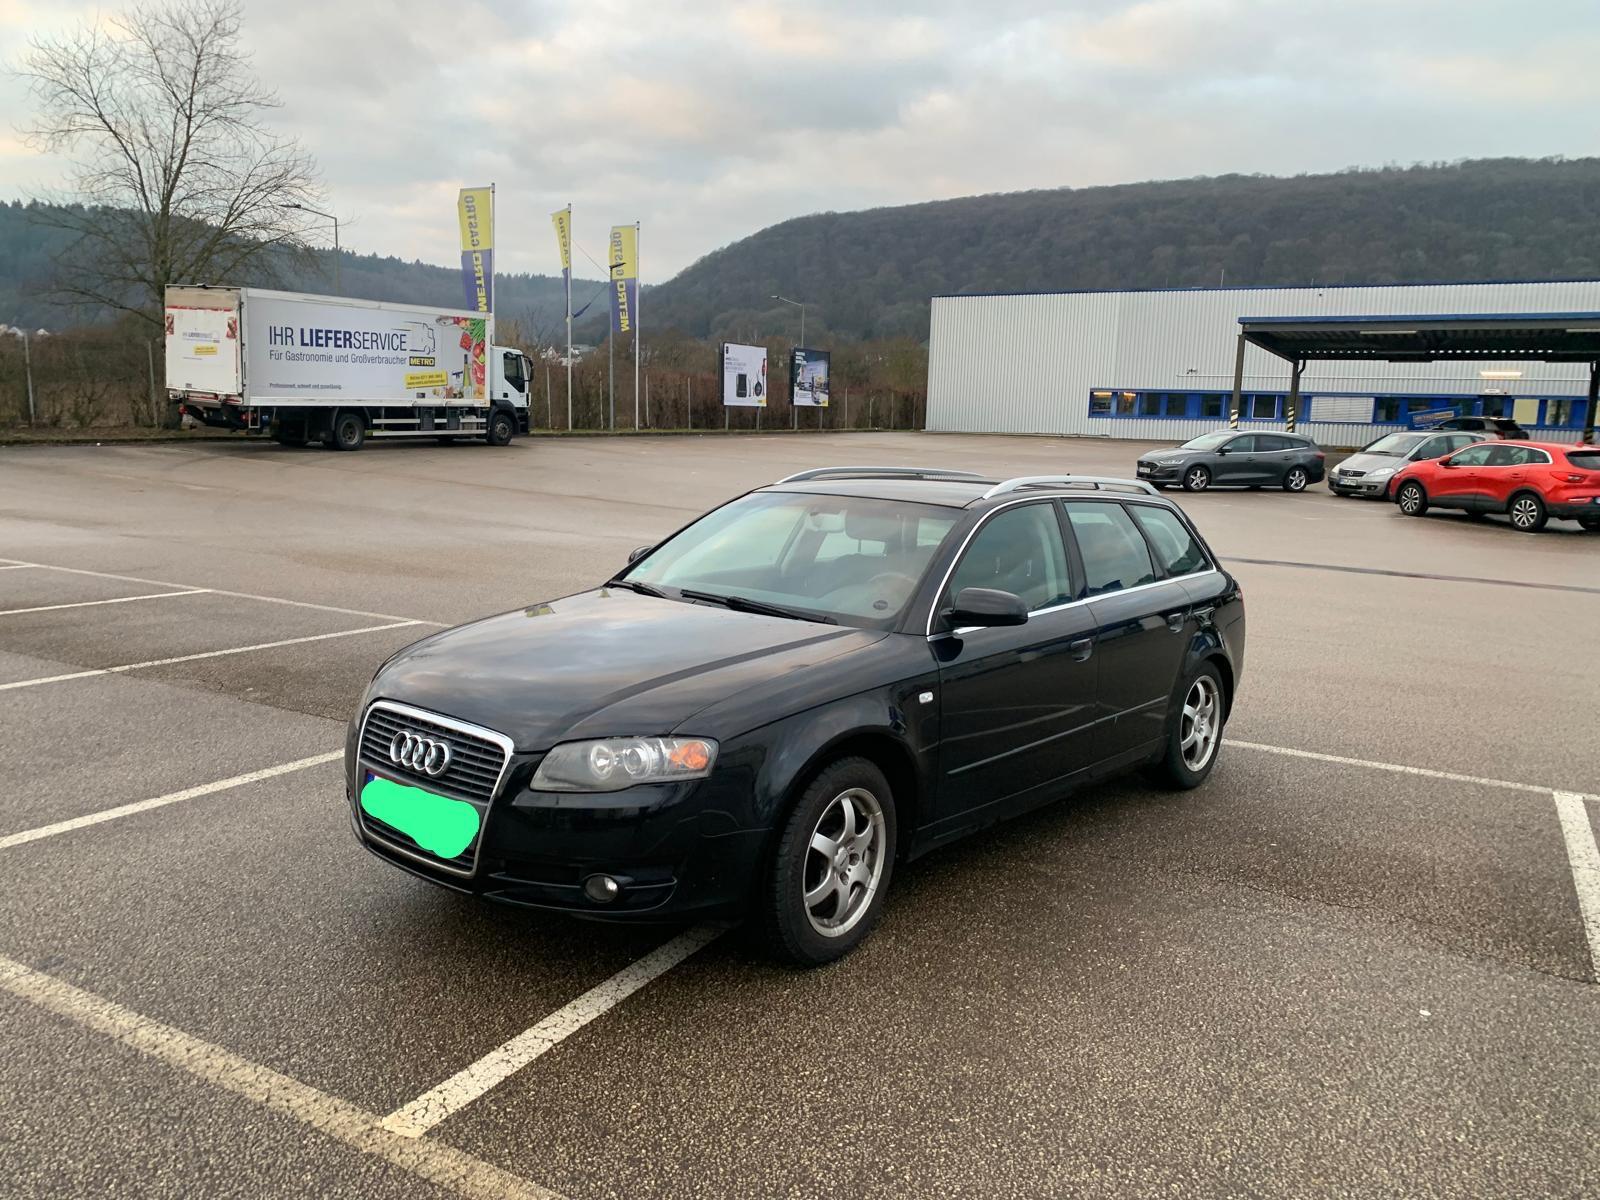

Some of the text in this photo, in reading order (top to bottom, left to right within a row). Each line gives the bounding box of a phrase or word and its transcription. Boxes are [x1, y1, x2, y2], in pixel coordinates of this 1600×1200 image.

[269, 325, 407, 351] IHR LIEFERSERVICE
[269, 349, 407, 366] Für Gastronomie und Großverbraucher
[410, 357, 434, 366] METRO
